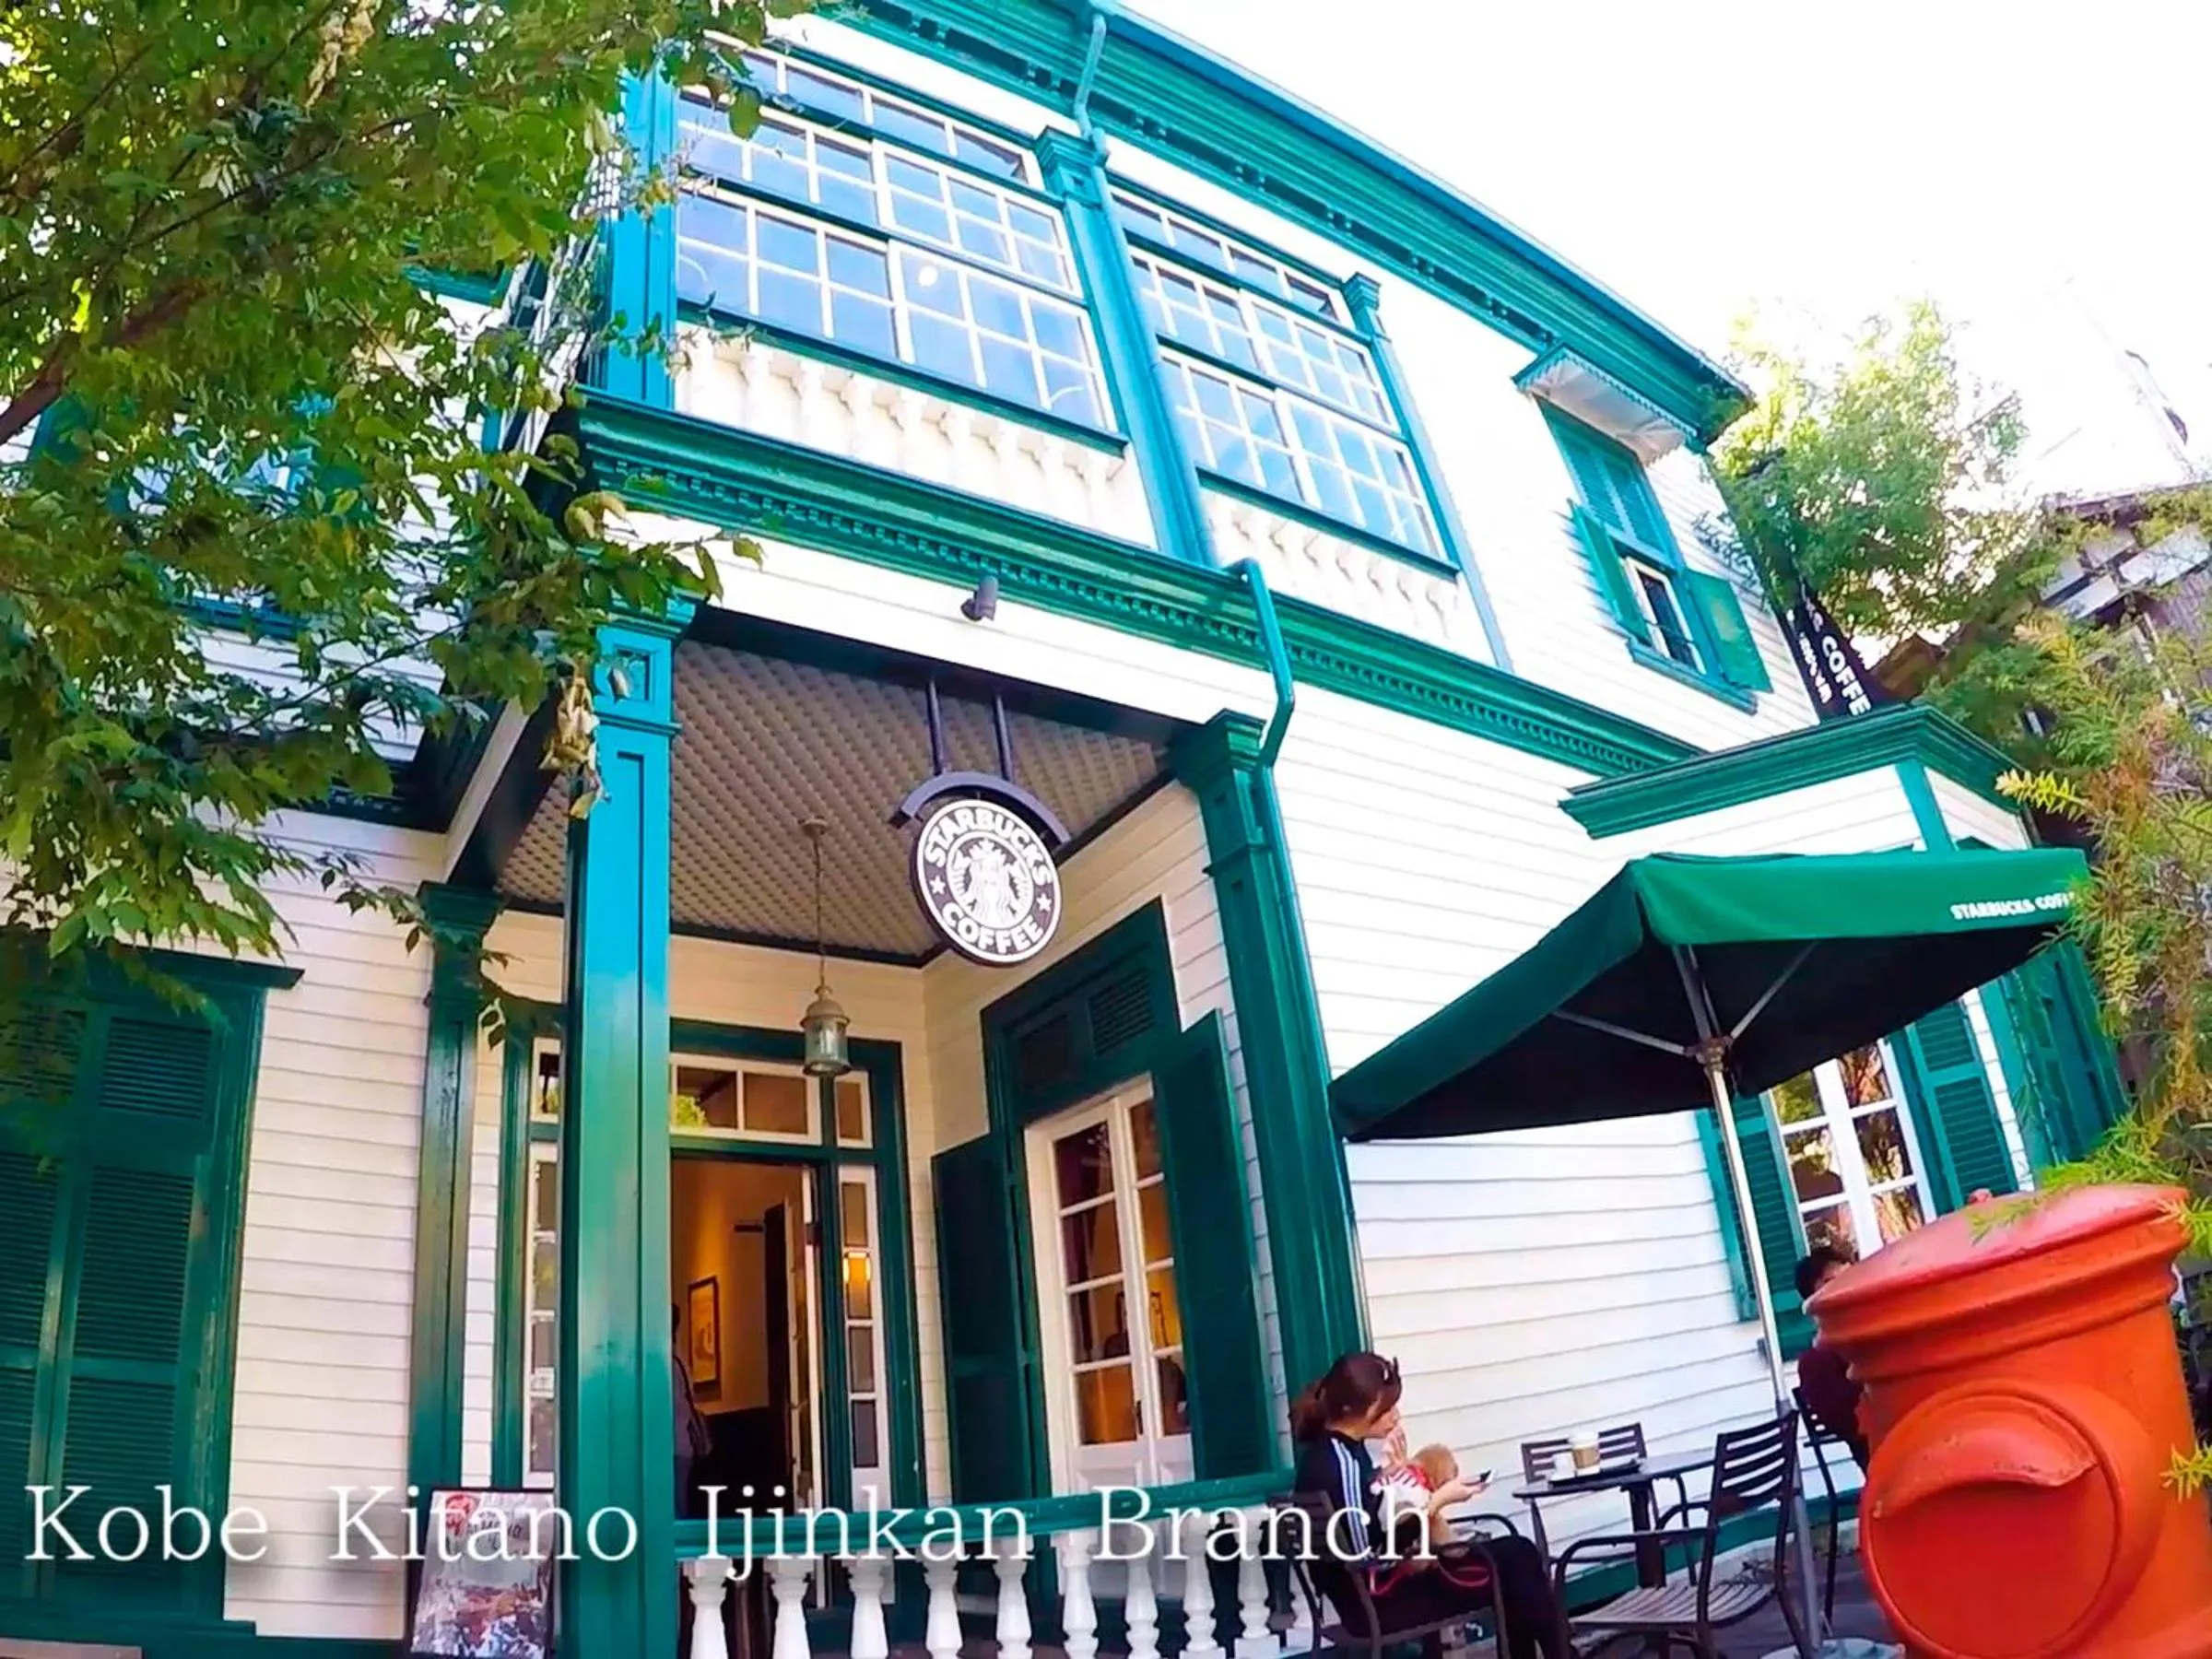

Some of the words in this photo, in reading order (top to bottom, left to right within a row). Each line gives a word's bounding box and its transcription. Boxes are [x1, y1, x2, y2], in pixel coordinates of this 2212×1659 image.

[1822, 635, 1871, 716] COFFE
[924, 807, 1053, 886] STARBUCKS
[941, 901, 1043, 954] COFFEE
[1950, 899, 2036, 920] STARBUCKS
